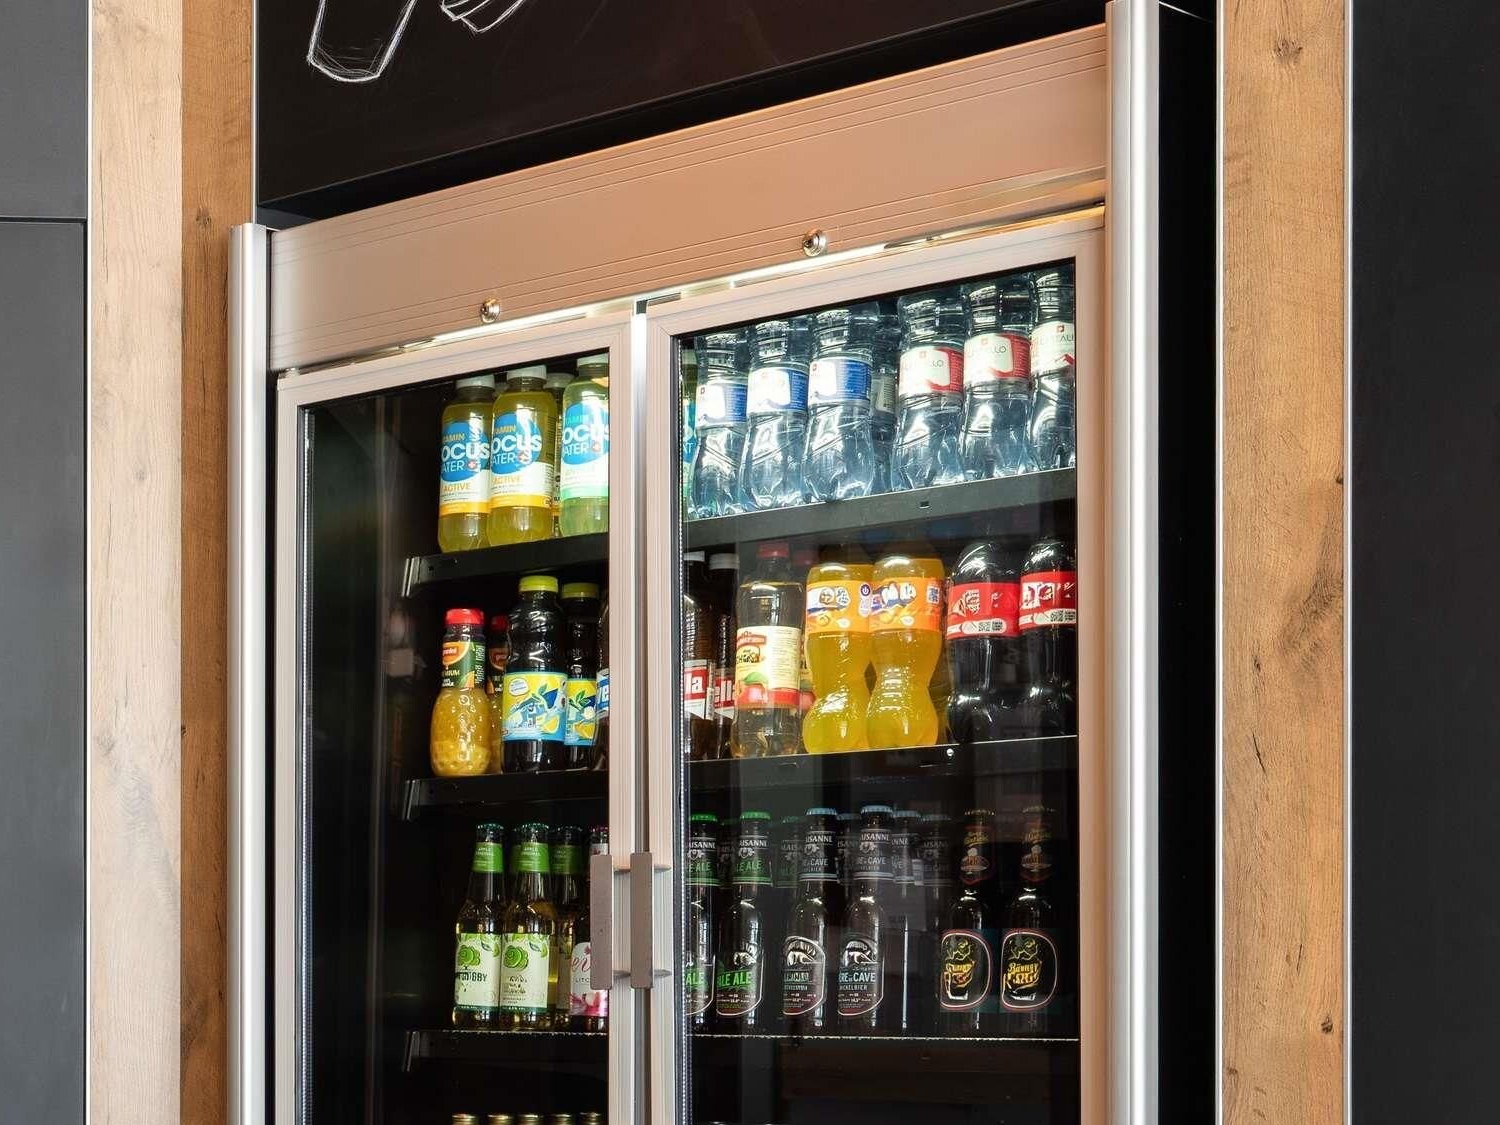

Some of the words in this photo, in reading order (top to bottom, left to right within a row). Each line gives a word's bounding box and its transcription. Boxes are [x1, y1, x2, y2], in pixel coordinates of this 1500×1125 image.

[563, 422, 609, 441] OCUS
[442, 442, 490, 460] OCUS
[491, 434, 542, 453] OCUS
[564, 443, 589, 456] ATER
[492, 453, 516, 465] ATER
[442, 461, 465, 473] ATER
